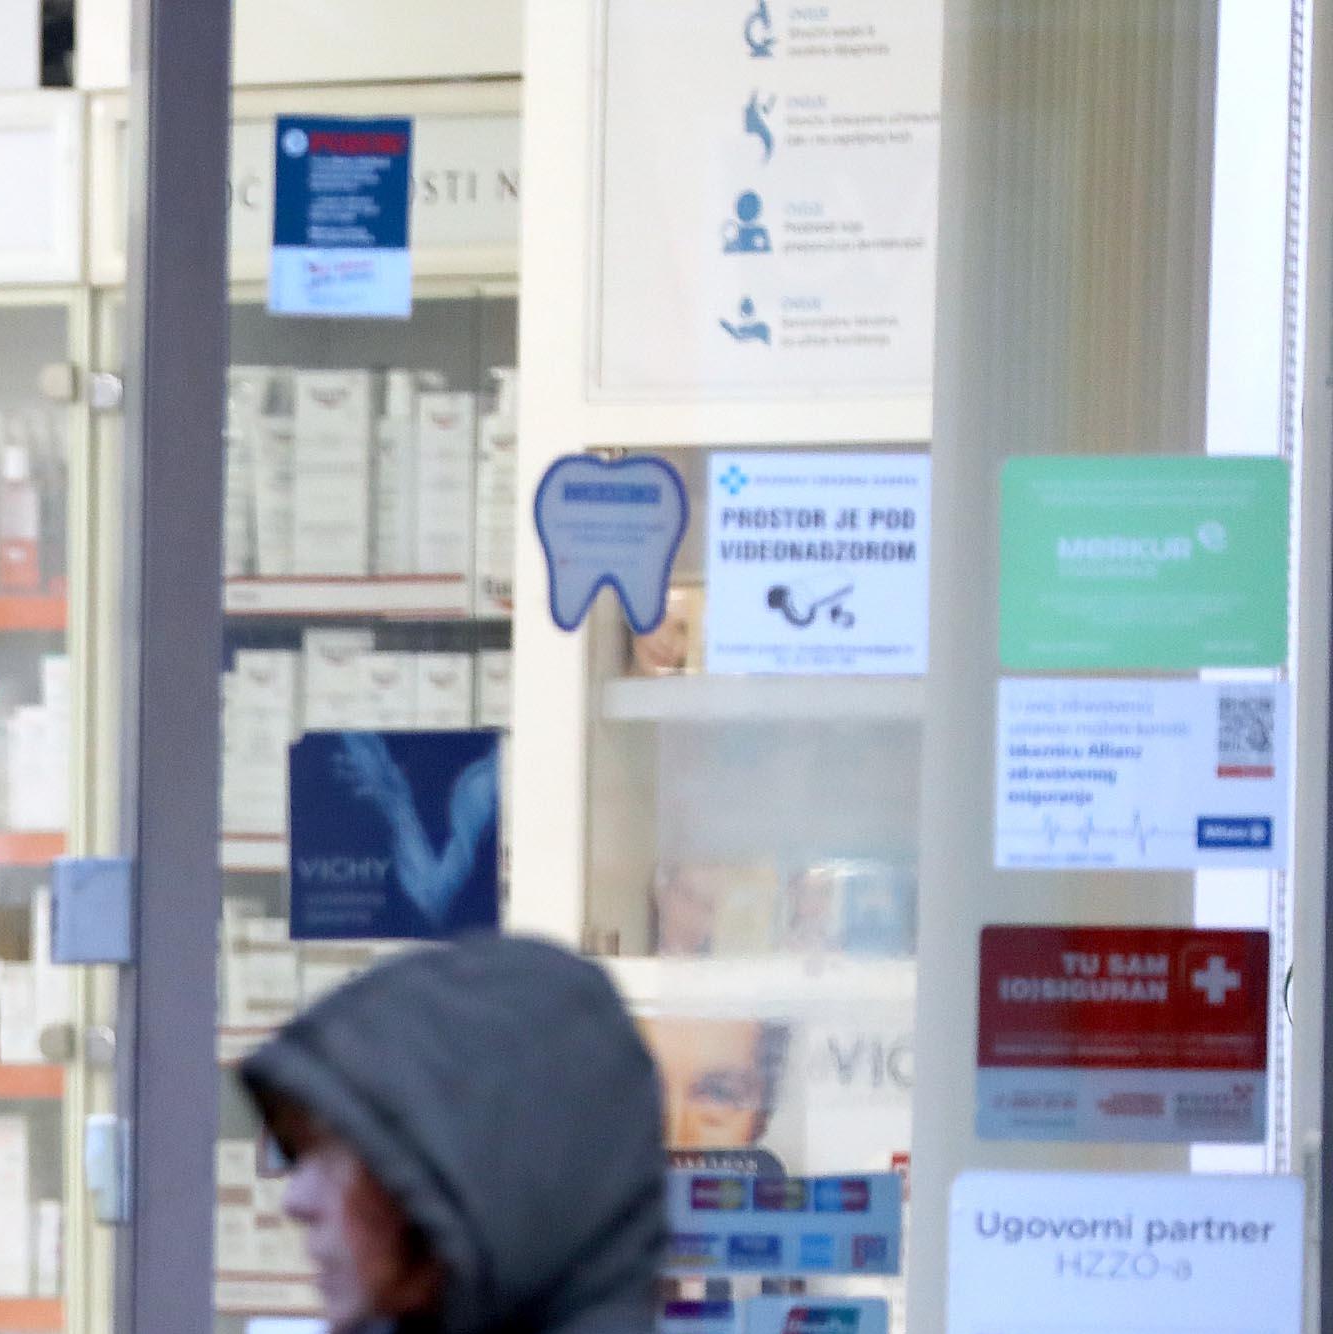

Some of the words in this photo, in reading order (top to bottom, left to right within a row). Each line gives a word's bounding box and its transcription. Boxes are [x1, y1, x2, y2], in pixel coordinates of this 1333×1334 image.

[720, 506, 827, 530] PROSTOR
[869, 507, 916, 530] POD
[1061, 952, 1101, 977] TU
[1107, 953, 1170, 977] SAM
[974, 1210, 1133, 1244] Ugovorni
[1145, 1216, 1276, 1246] partner
